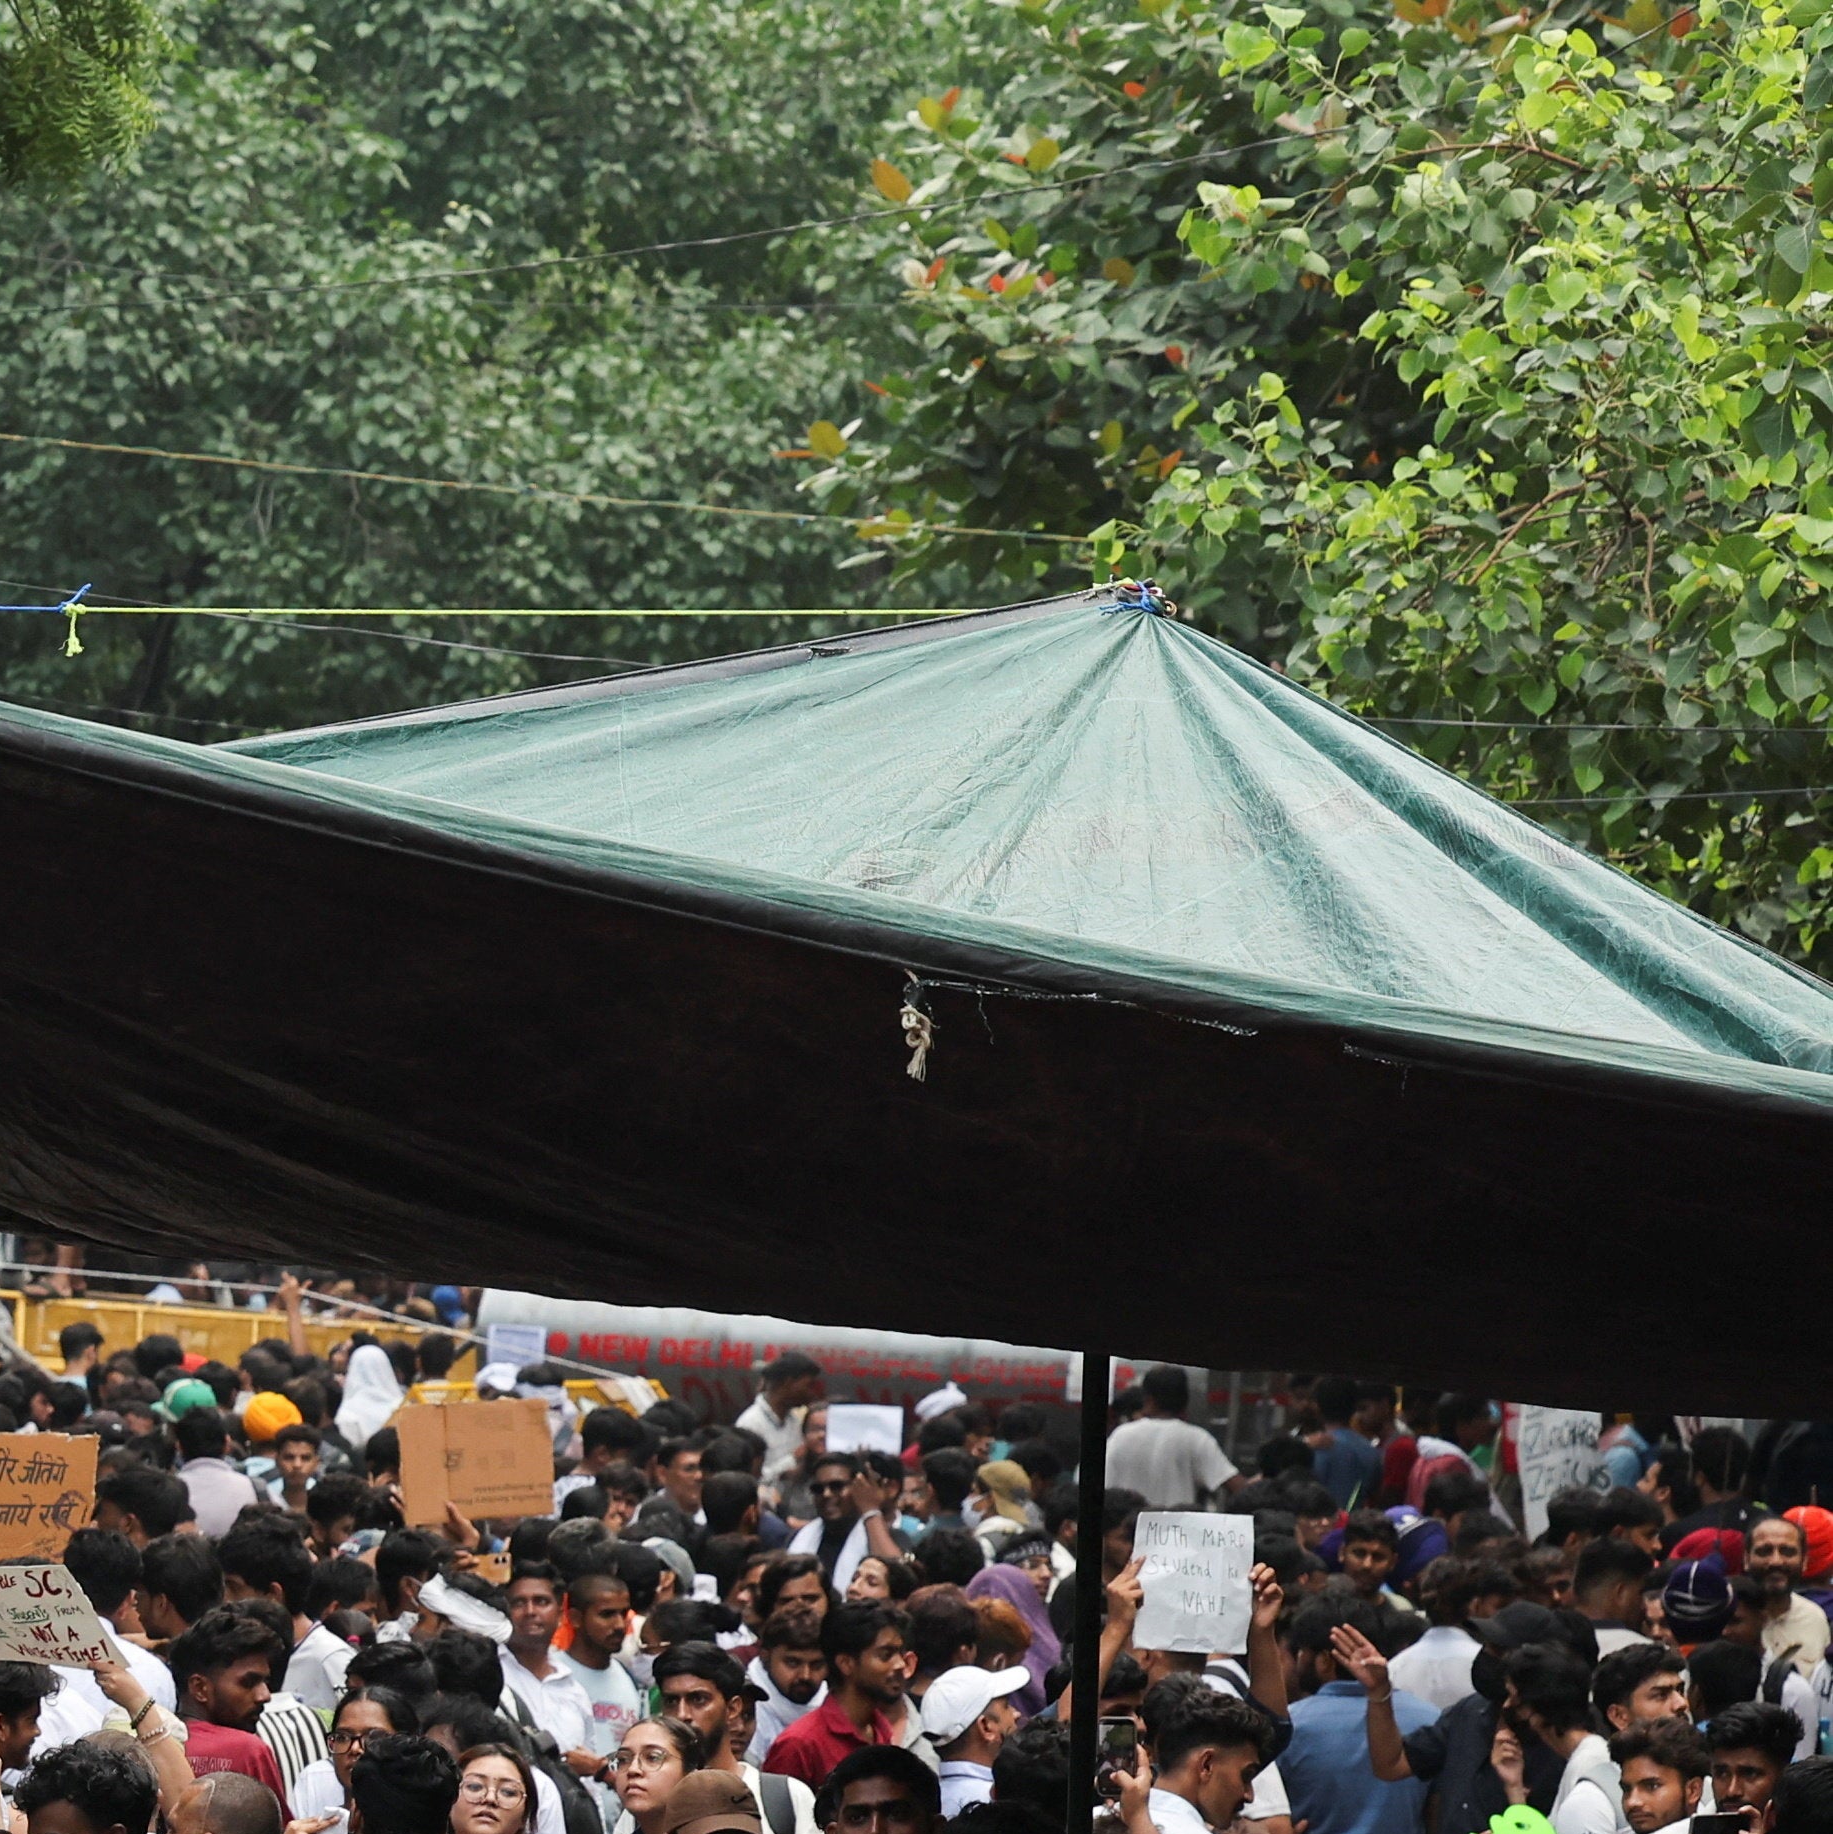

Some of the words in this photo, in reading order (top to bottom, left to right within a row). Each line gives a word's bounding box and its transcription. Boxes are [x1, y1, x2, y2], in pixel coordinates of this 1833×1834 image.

[579, 1332, 651, 1363] NEW
[659, 1338, 754, 1369] DELHI
[25, 1570, 72, 1598] SC,
[55, 1606, 85, 1618] FROM
[1183, 1590, 1226, 1616] NAHI
[30, 1622, 59, 1643] NOT
[67, 1626, 80, 1642] A
